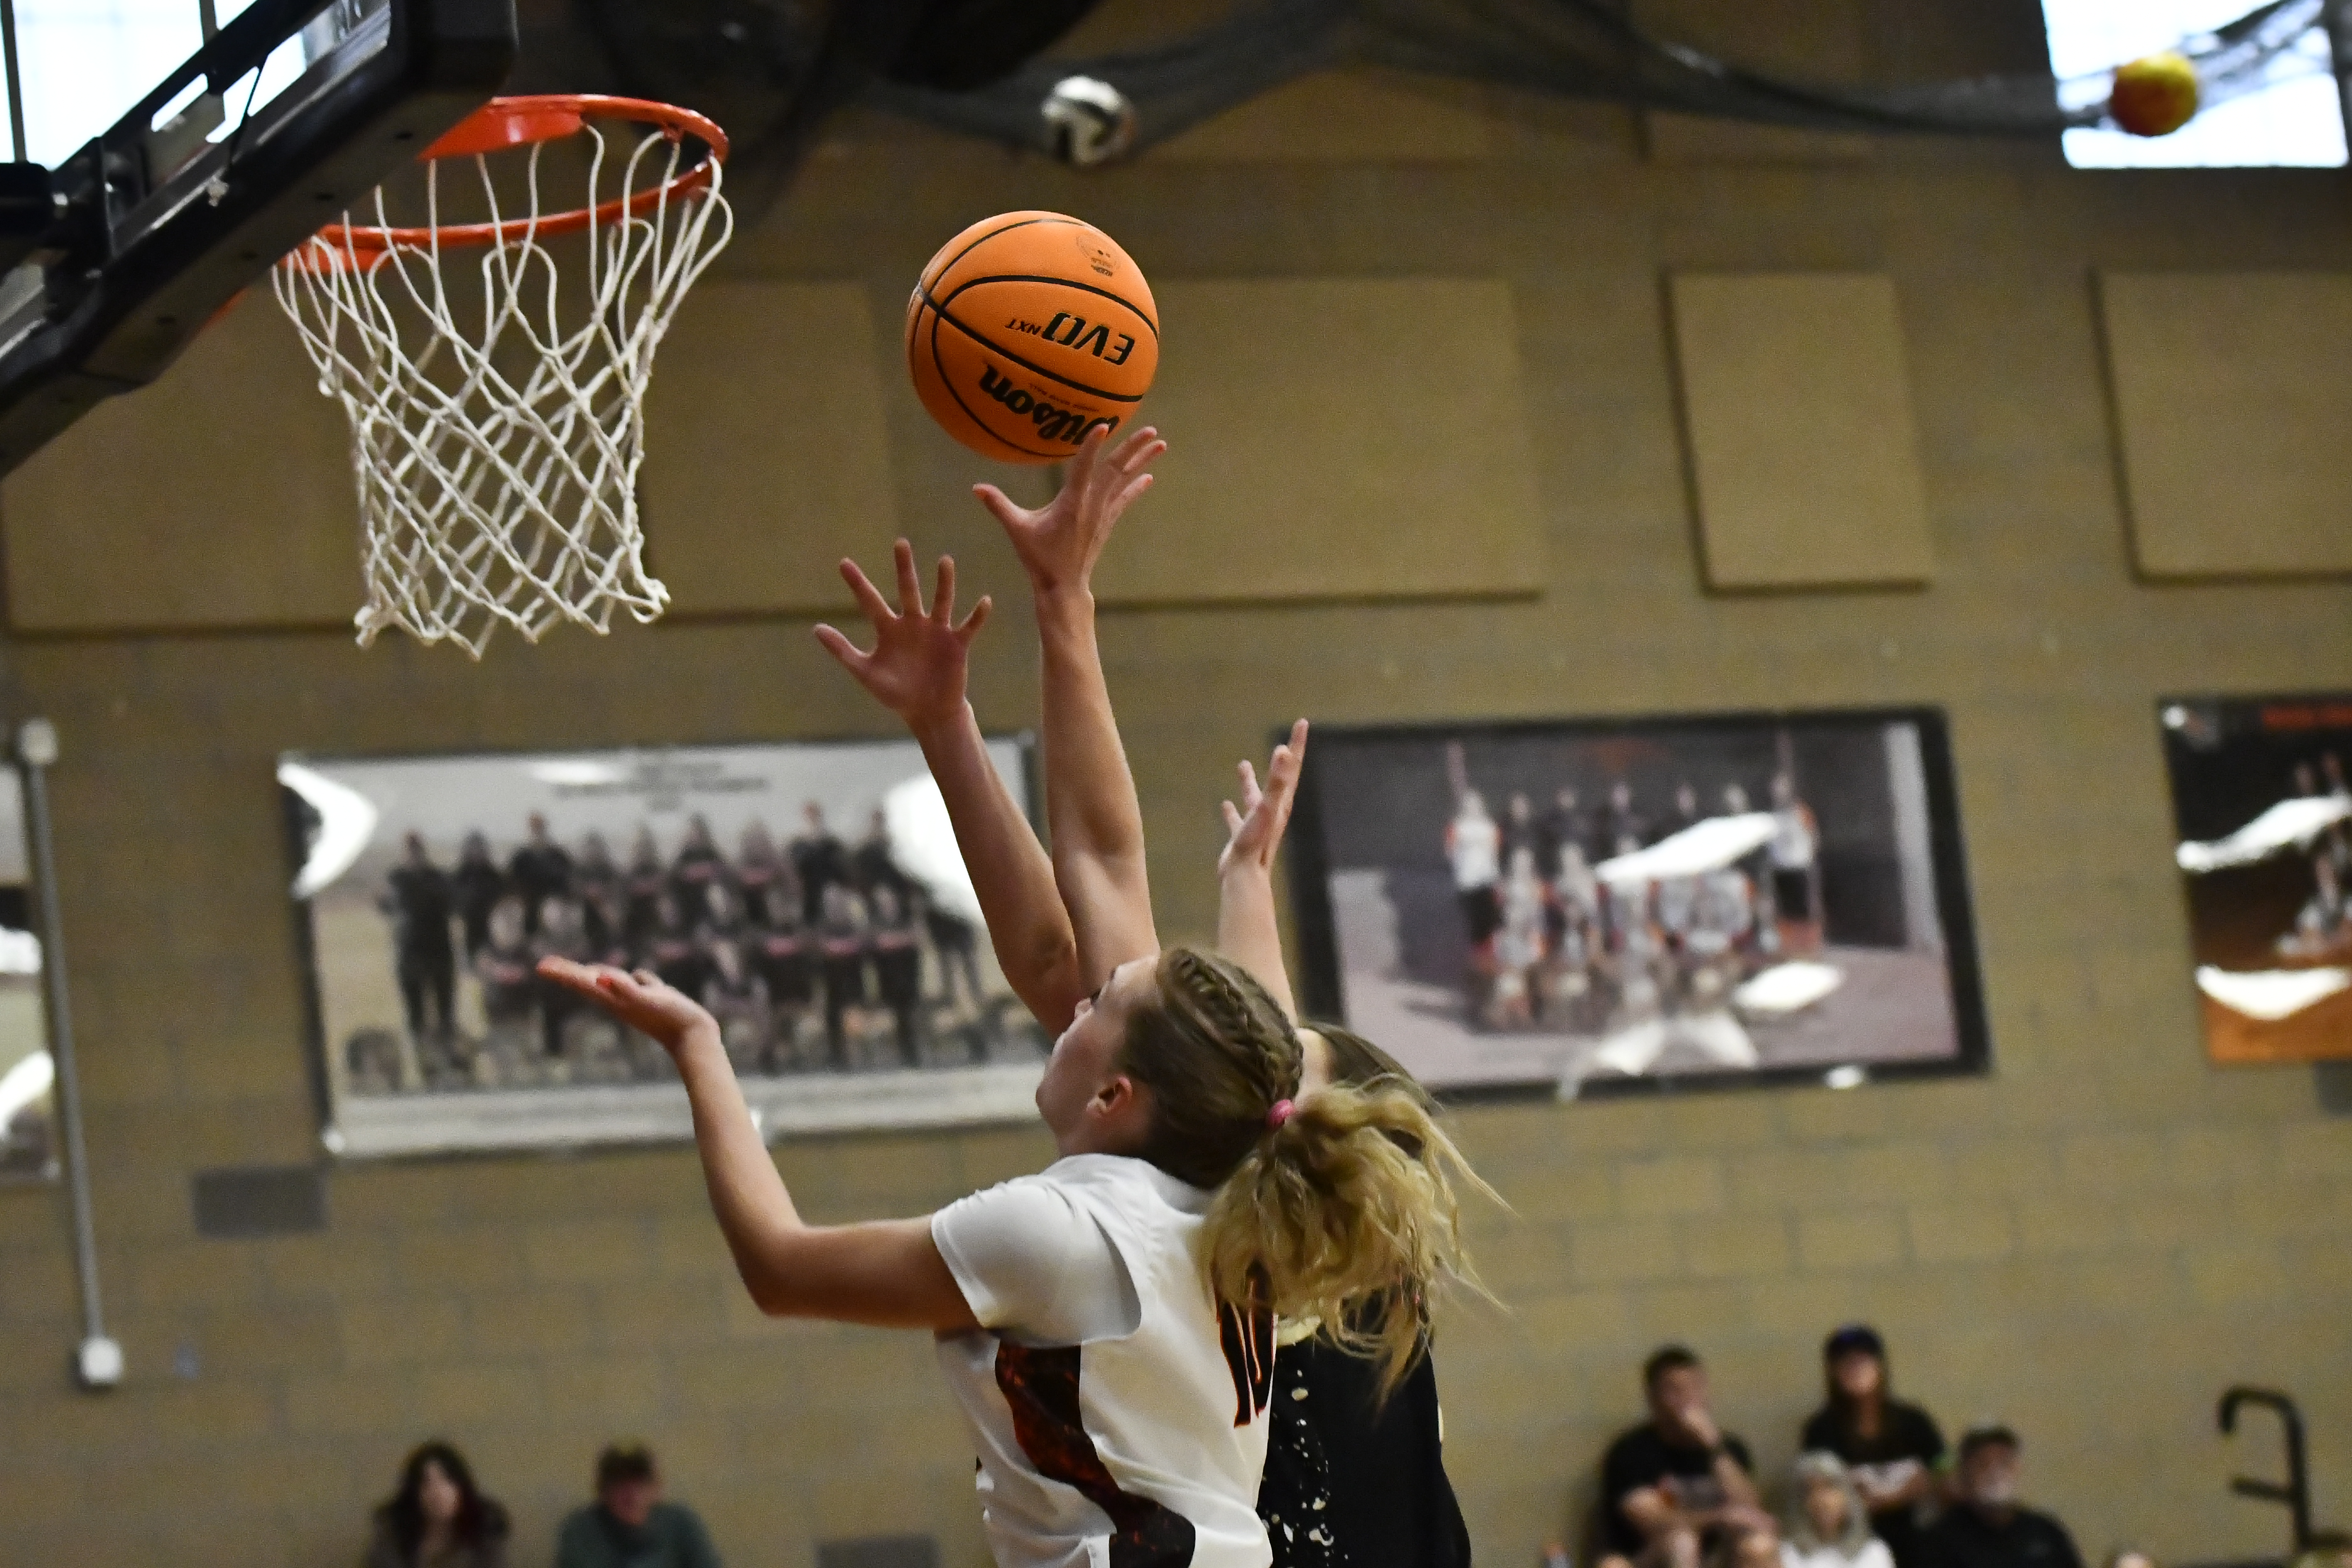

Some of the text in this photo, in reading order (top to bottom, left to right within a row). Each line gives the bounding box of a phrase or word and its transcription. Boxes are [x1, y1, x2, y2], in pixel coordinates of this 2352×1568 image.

[1005, 313, 1135, 365] EVO NXT
[979, 363, 1119, 445] Wilson
